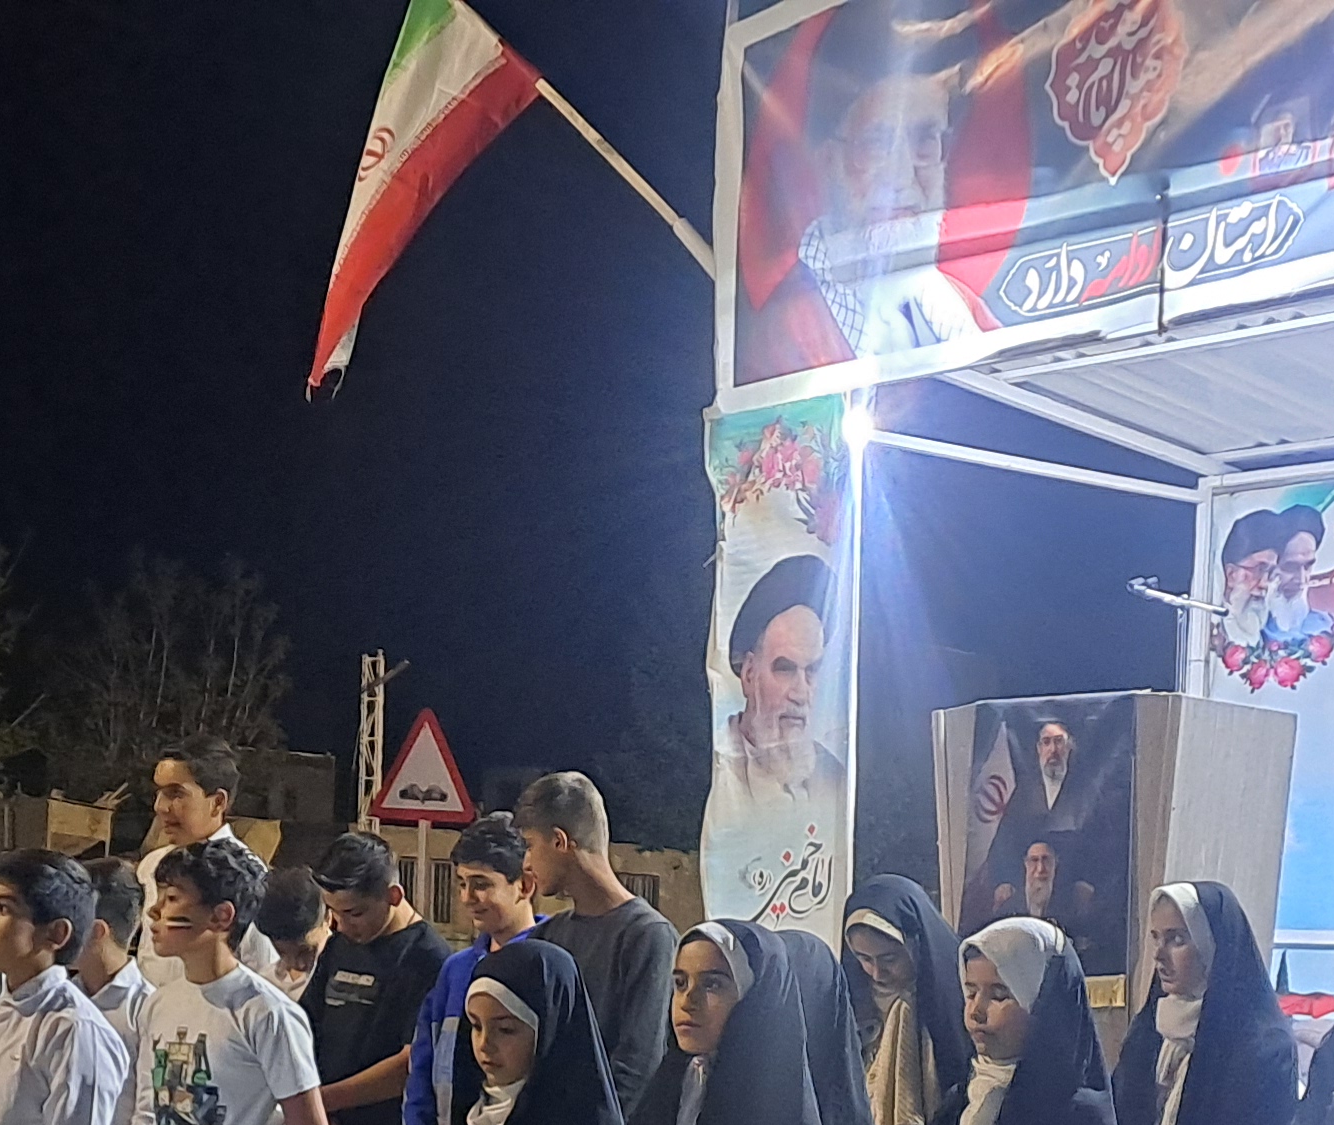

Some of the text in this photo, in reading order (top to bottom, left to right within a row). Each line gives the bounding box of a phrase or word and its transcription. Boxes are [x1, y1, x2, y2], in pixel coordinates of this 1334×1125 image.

[1021, 242, 1085, 311] دارد
[1164, 194, 1294, 290] راهتان
[750, 823, 823, 929] خمینی
[788, 854, 833, 915] امام
